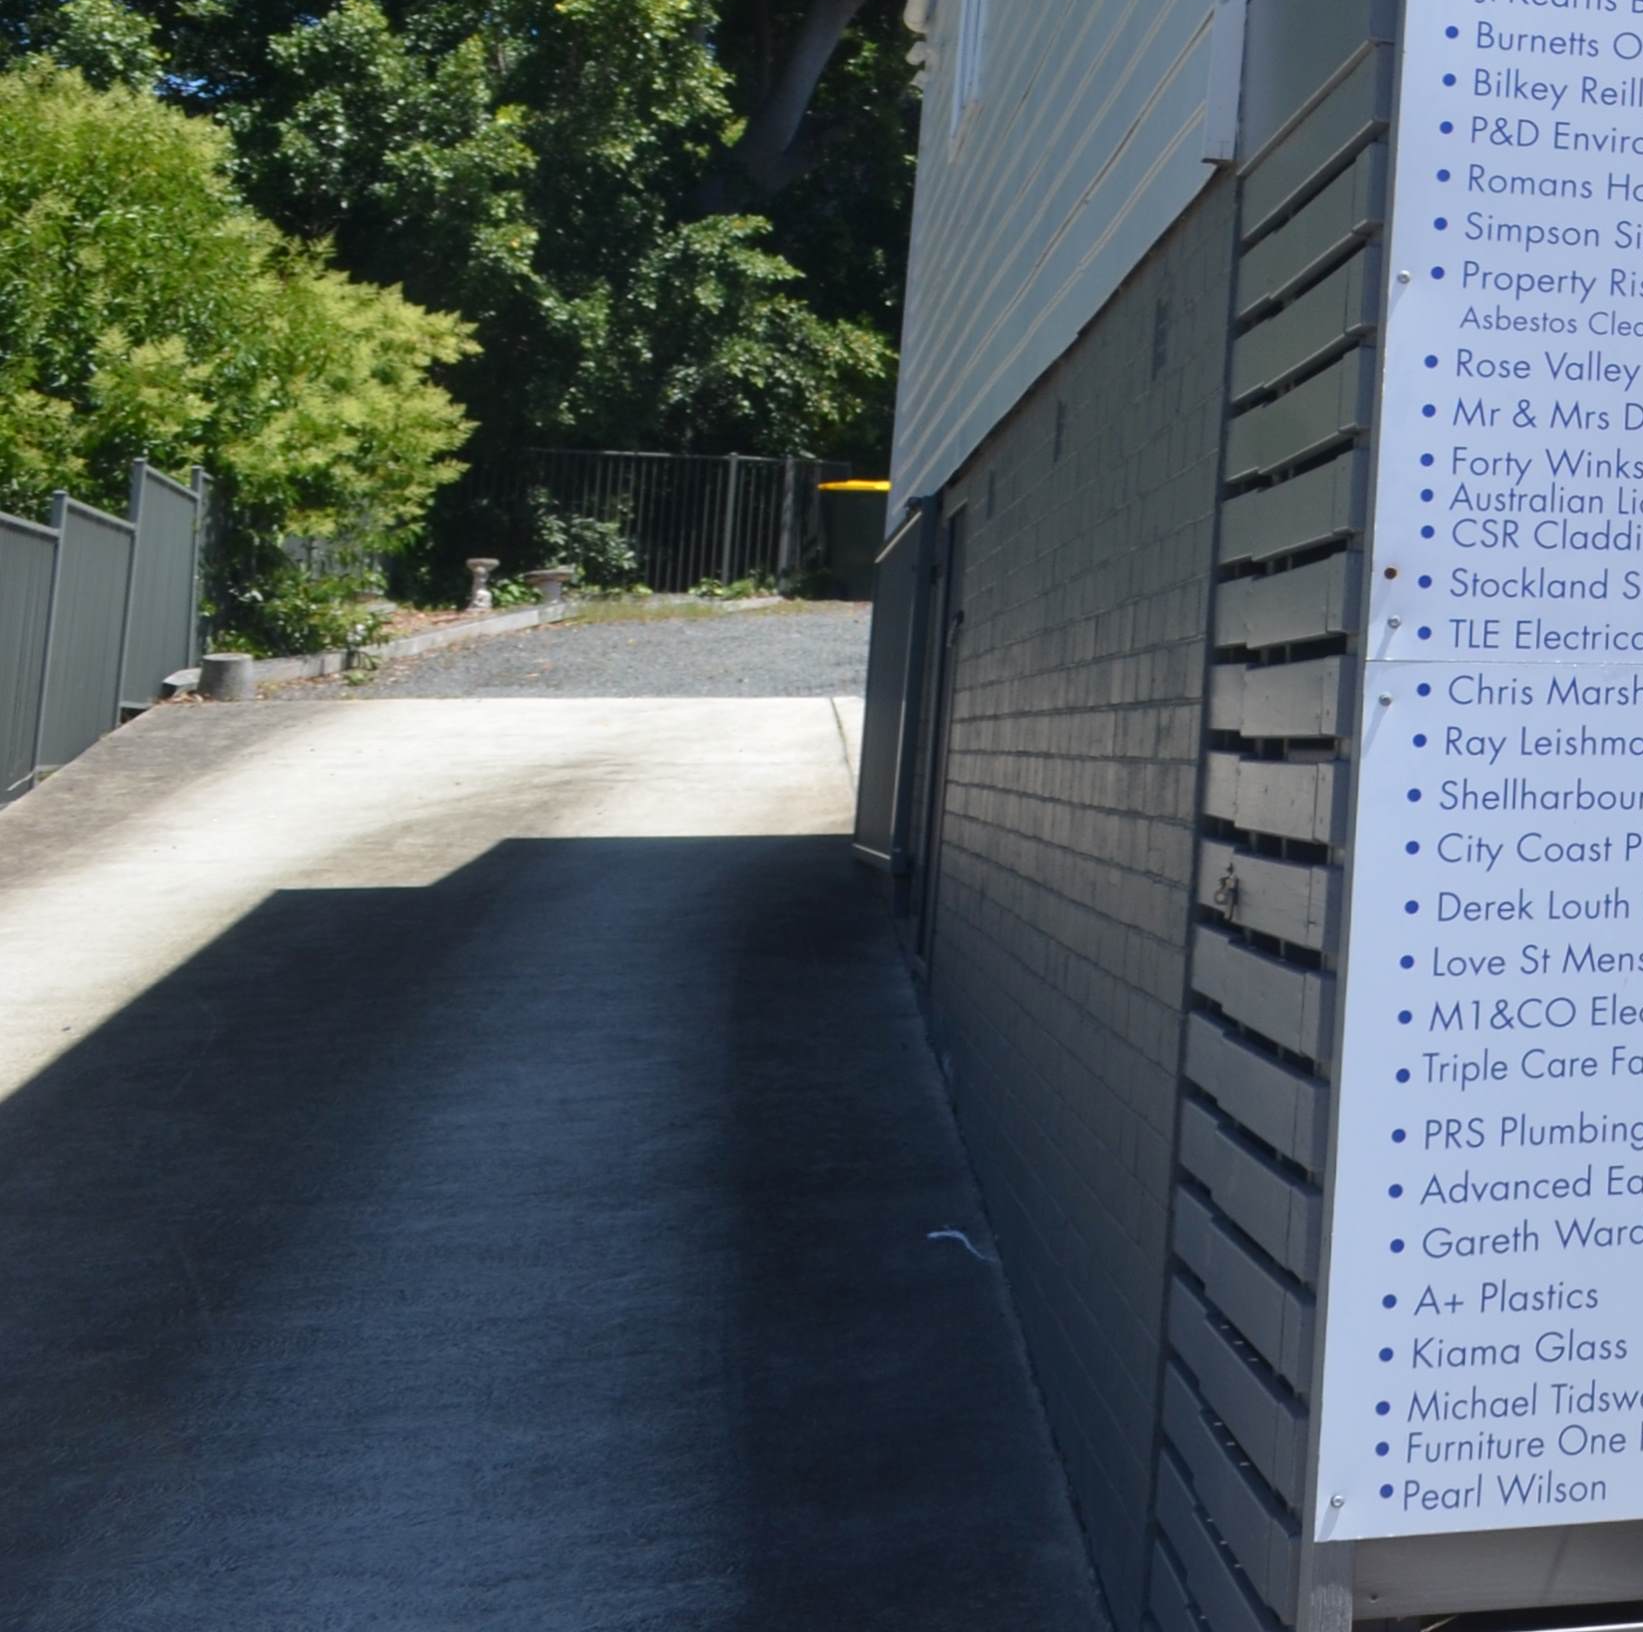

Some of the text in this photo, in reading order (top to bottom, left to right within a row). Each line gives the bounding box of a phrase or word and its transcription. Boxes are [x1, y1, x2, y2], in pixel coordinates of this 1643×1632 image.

[1477, 21, 1599, 57] Burnetts
[1474, 68, 1568, 111] Bilkey
[1472, 116, 1539, 147] P&D
[1465, 211, 1599, 252] Simpson
[1463, 260, 1597, 304] Property
[1460, 304, 1577, 334] Asbestos
[1456, 348, 1531, 379] Rose
[1545, 350, 1640, 392] Valley
[1453, 397, 1501, 427] Mr
[1512, 399, 1536, 428] &
[1550, 400, 1610, 430] Mrs
[1449, 481, 1603, 514] Australian
[1452, 518, 1519, 548] CSR
[1450, 566, 1608, 599] Stockland
[1448, 619, 1500, 648] TLE
[1448, 673, 1533, 705] Chris
[1446, 726, 1507, 765] Ray
[1438, 888, 1534, 922] Derek
[1549, 887, 1629, 919] Louth
[1433, 946, 1506, 976] Love
[1520, 944, 1550, 975] St
[1429, 997, 1576, 1032] M1&CO
[1422, 1048, 1508, 1088] Triple
[1521, 1048, 1598, 1079] Care
[1425, 1117, 1485, 1150] PRS
[1420, 1164, 1592, 1205] Advanced
[1414, 1279, 1598, 1316] A+ Plastics
[1413, 1328, 1627, 1368] Kiama Glass
[1407, 1382, 1537, 1422] Michael
[1404, 1469, 1606, 1511] Pearl Wilson
